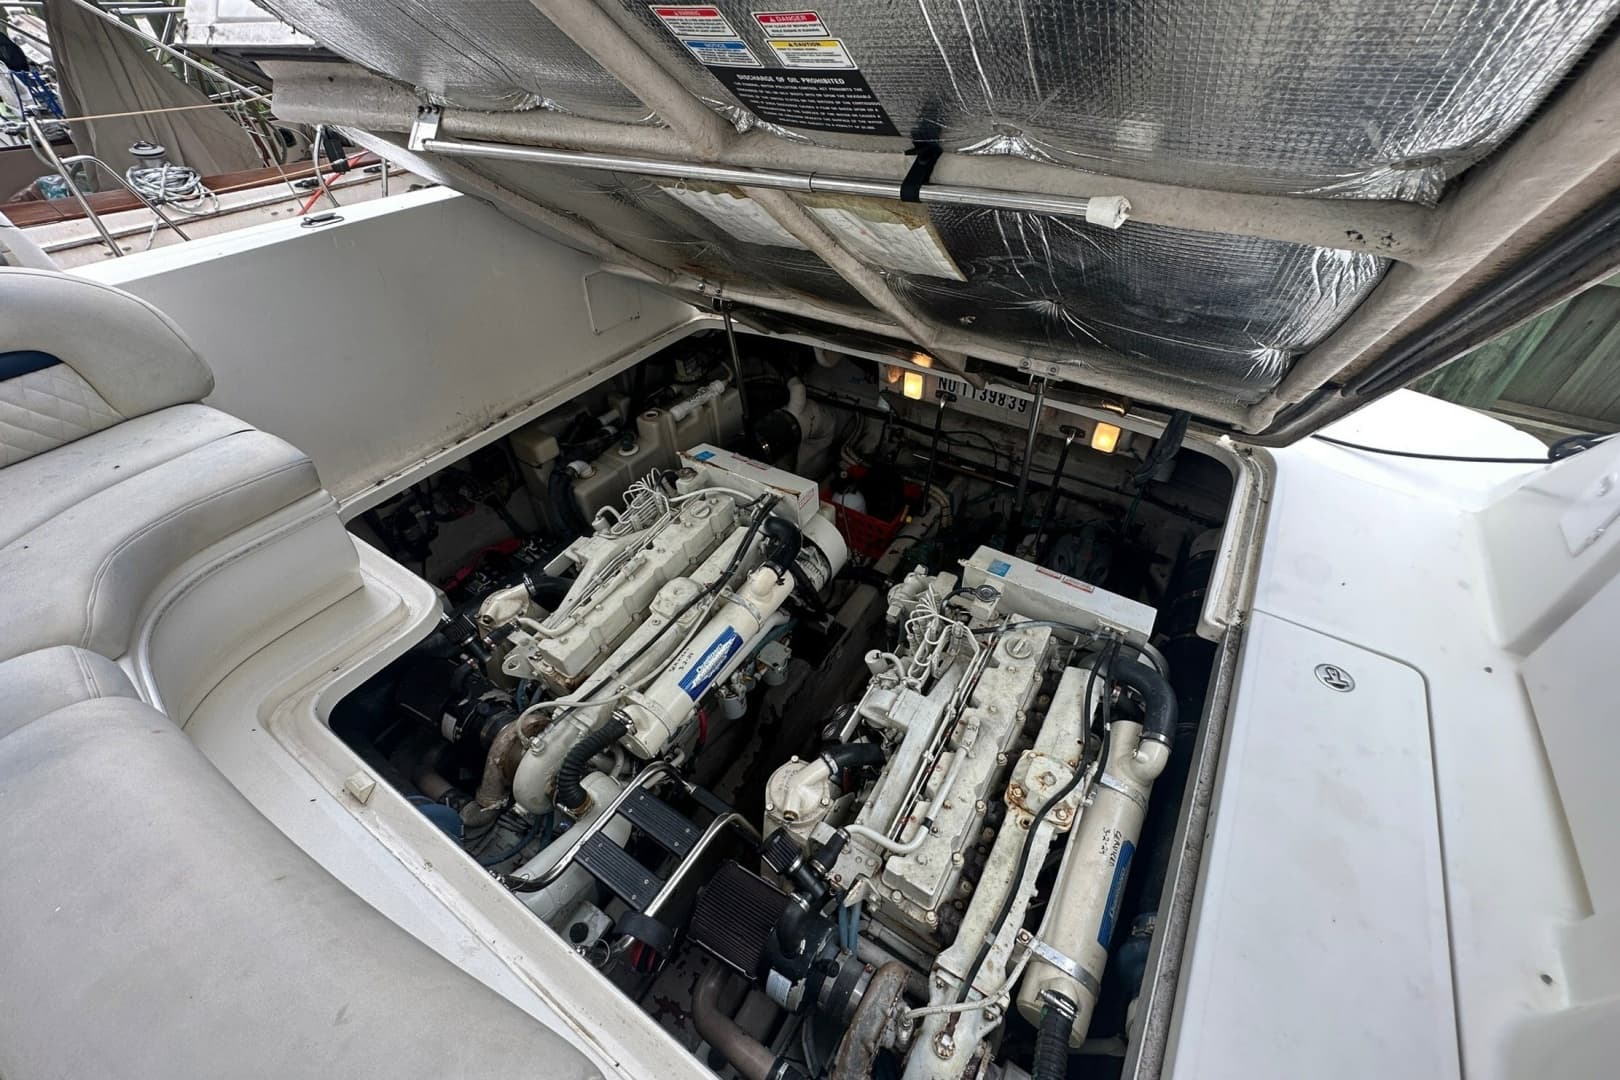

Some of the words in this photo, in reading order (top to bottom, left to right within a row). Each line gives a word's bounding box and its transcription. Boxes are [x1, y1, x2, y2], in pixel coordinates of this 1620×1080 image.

[775, 15, 807, 23] DANGER
[736, 74, 775, 82] DISCHARGE
[800, 77, 846, 85] PROHIBITED
